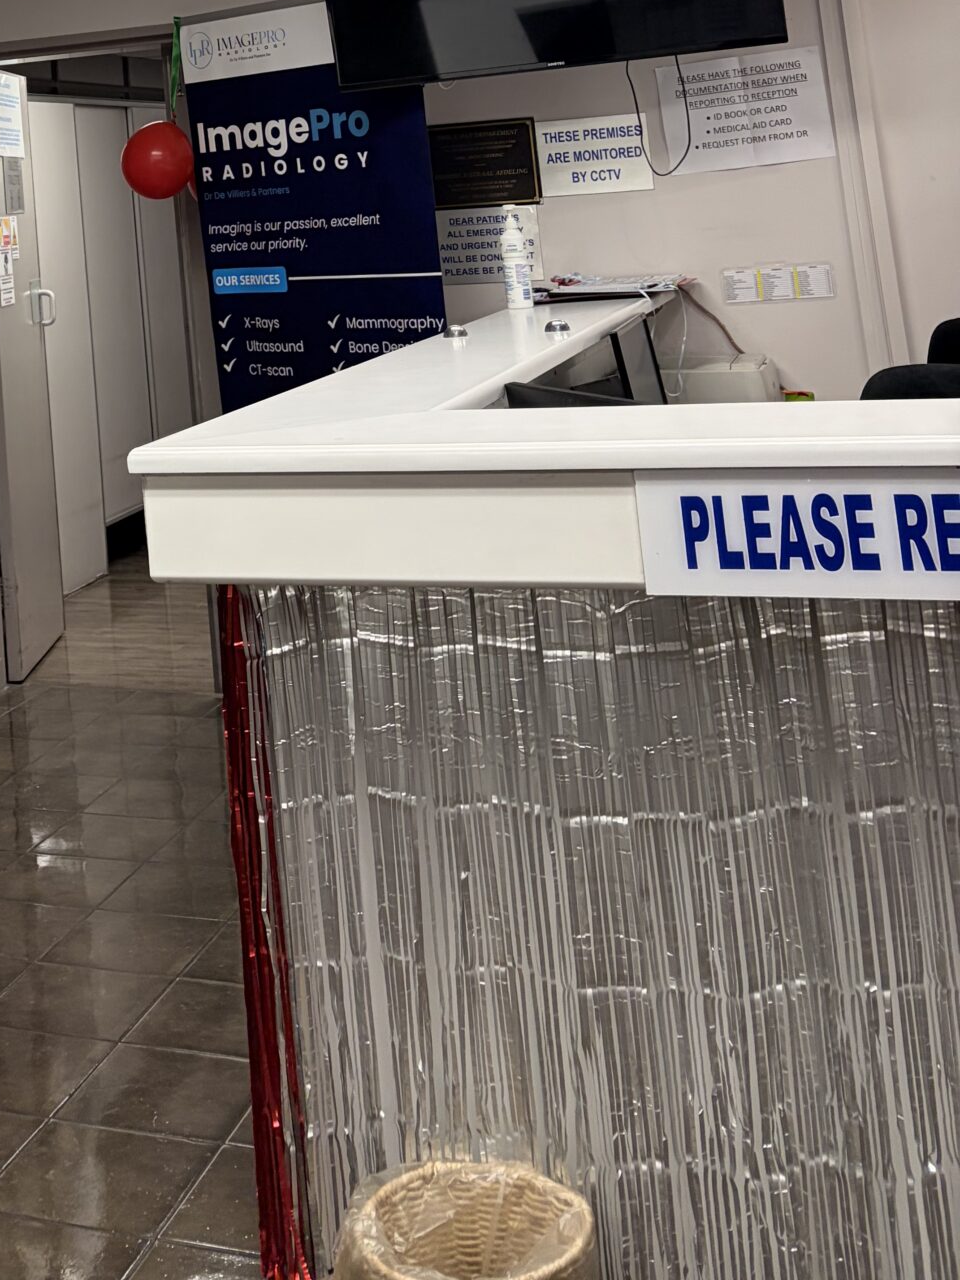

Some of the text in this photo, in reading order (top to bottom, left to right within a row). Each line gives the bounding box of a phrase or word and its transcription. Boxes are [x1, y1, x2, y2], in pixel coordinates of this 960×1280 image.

[217, 28, 286, 51] IMAGEPRO
[708, 70, 731, 81] HAVE
[733, 67, 748, 76] THE
[750, 60, 801, 73] FOLLOWING
[675, 73, 807, 97] DOCUMENTATION READY WHEN
[688, 88, 798, 109] REPORTING TO RECEPTION
[725, 110, 748, 119] BOOK
[750, 108, 762, 116] OR
[764, 104, 787, 114] CARD
[197, 108, 370, 158] ImagePro
[542, 124, 642, 144] THESE PREMISES
[713, 118, 792, 134] MEDICAL AID CARD
[702, 130, 808, 150] REQUEST FORM FROM DR
[547, 146, 642, 164] ARE MONITORED
[202, 151, 369, 182] RADIOLOGY
[572, 169, 621, 183] BY CCTV
[204, 192, 213, 200] Dr
[214, 191, 225, 200] De
[227, 189, 250, 198] Villiers
[258, 186, 290, 196] Partners
[208, 214, 380, 237] Imaging is our passion, excellent
[449, 214, 519, 226] DEAR PATIENS
[447, 230, 464, 238] ALL
[210, 237, 308, 253] service our priority.
[440, 243, 458, 251] AND
[461, 241, 498, 250] URGENT
[442, 256, 463, 264] WILL
[466, 254, 478, 263] BE
[445, 267, 480, 277] PLEASE
[482, 267, 495, 275] BE
[216, 274, 280, 287] OUR SERVICES
[244, 317, 280, 333] X-Rays
[346, 316, 444, 332] Mammography
[246, 340, 305, 353] Ultrasound
[348, 340, 380, 353] Bone
[249, 363, 293, 377] CT-scan
[680, 493, 960, 572] PLEASE RE
